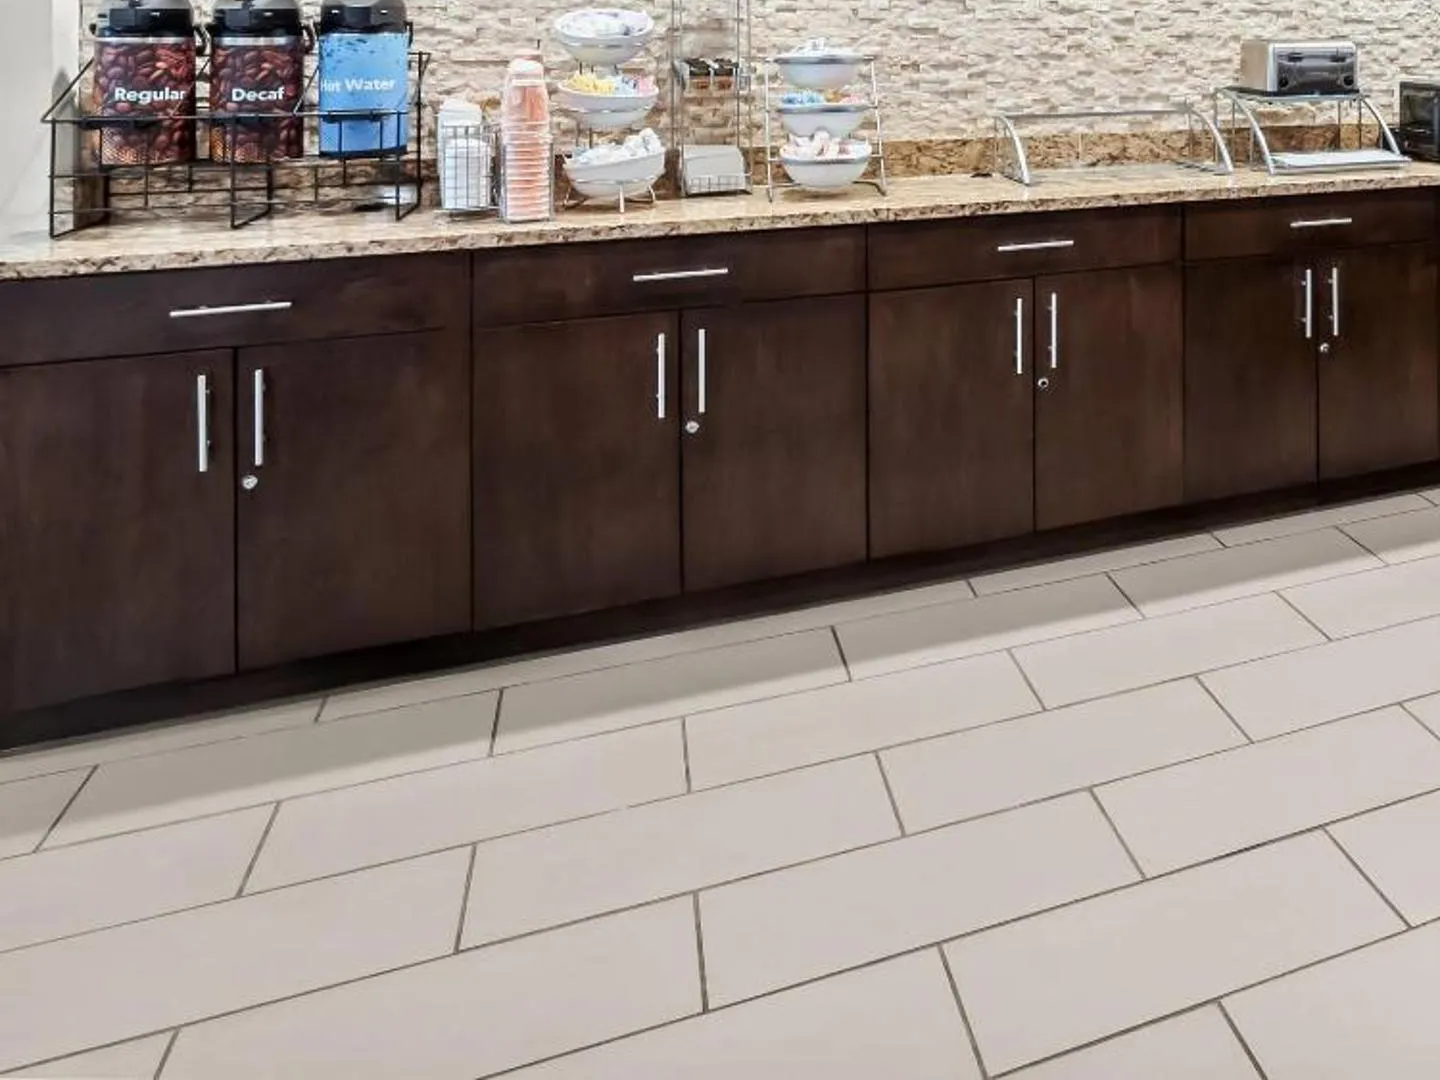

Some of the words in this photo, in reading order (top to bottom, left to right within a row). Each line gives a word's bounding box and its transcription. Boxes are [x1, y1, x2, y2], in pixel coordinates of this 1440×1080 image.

[343, 77, 396, 92] Water
[114, 87, 186, 104] Regular
[231, 86, 285, 101] Decaf
